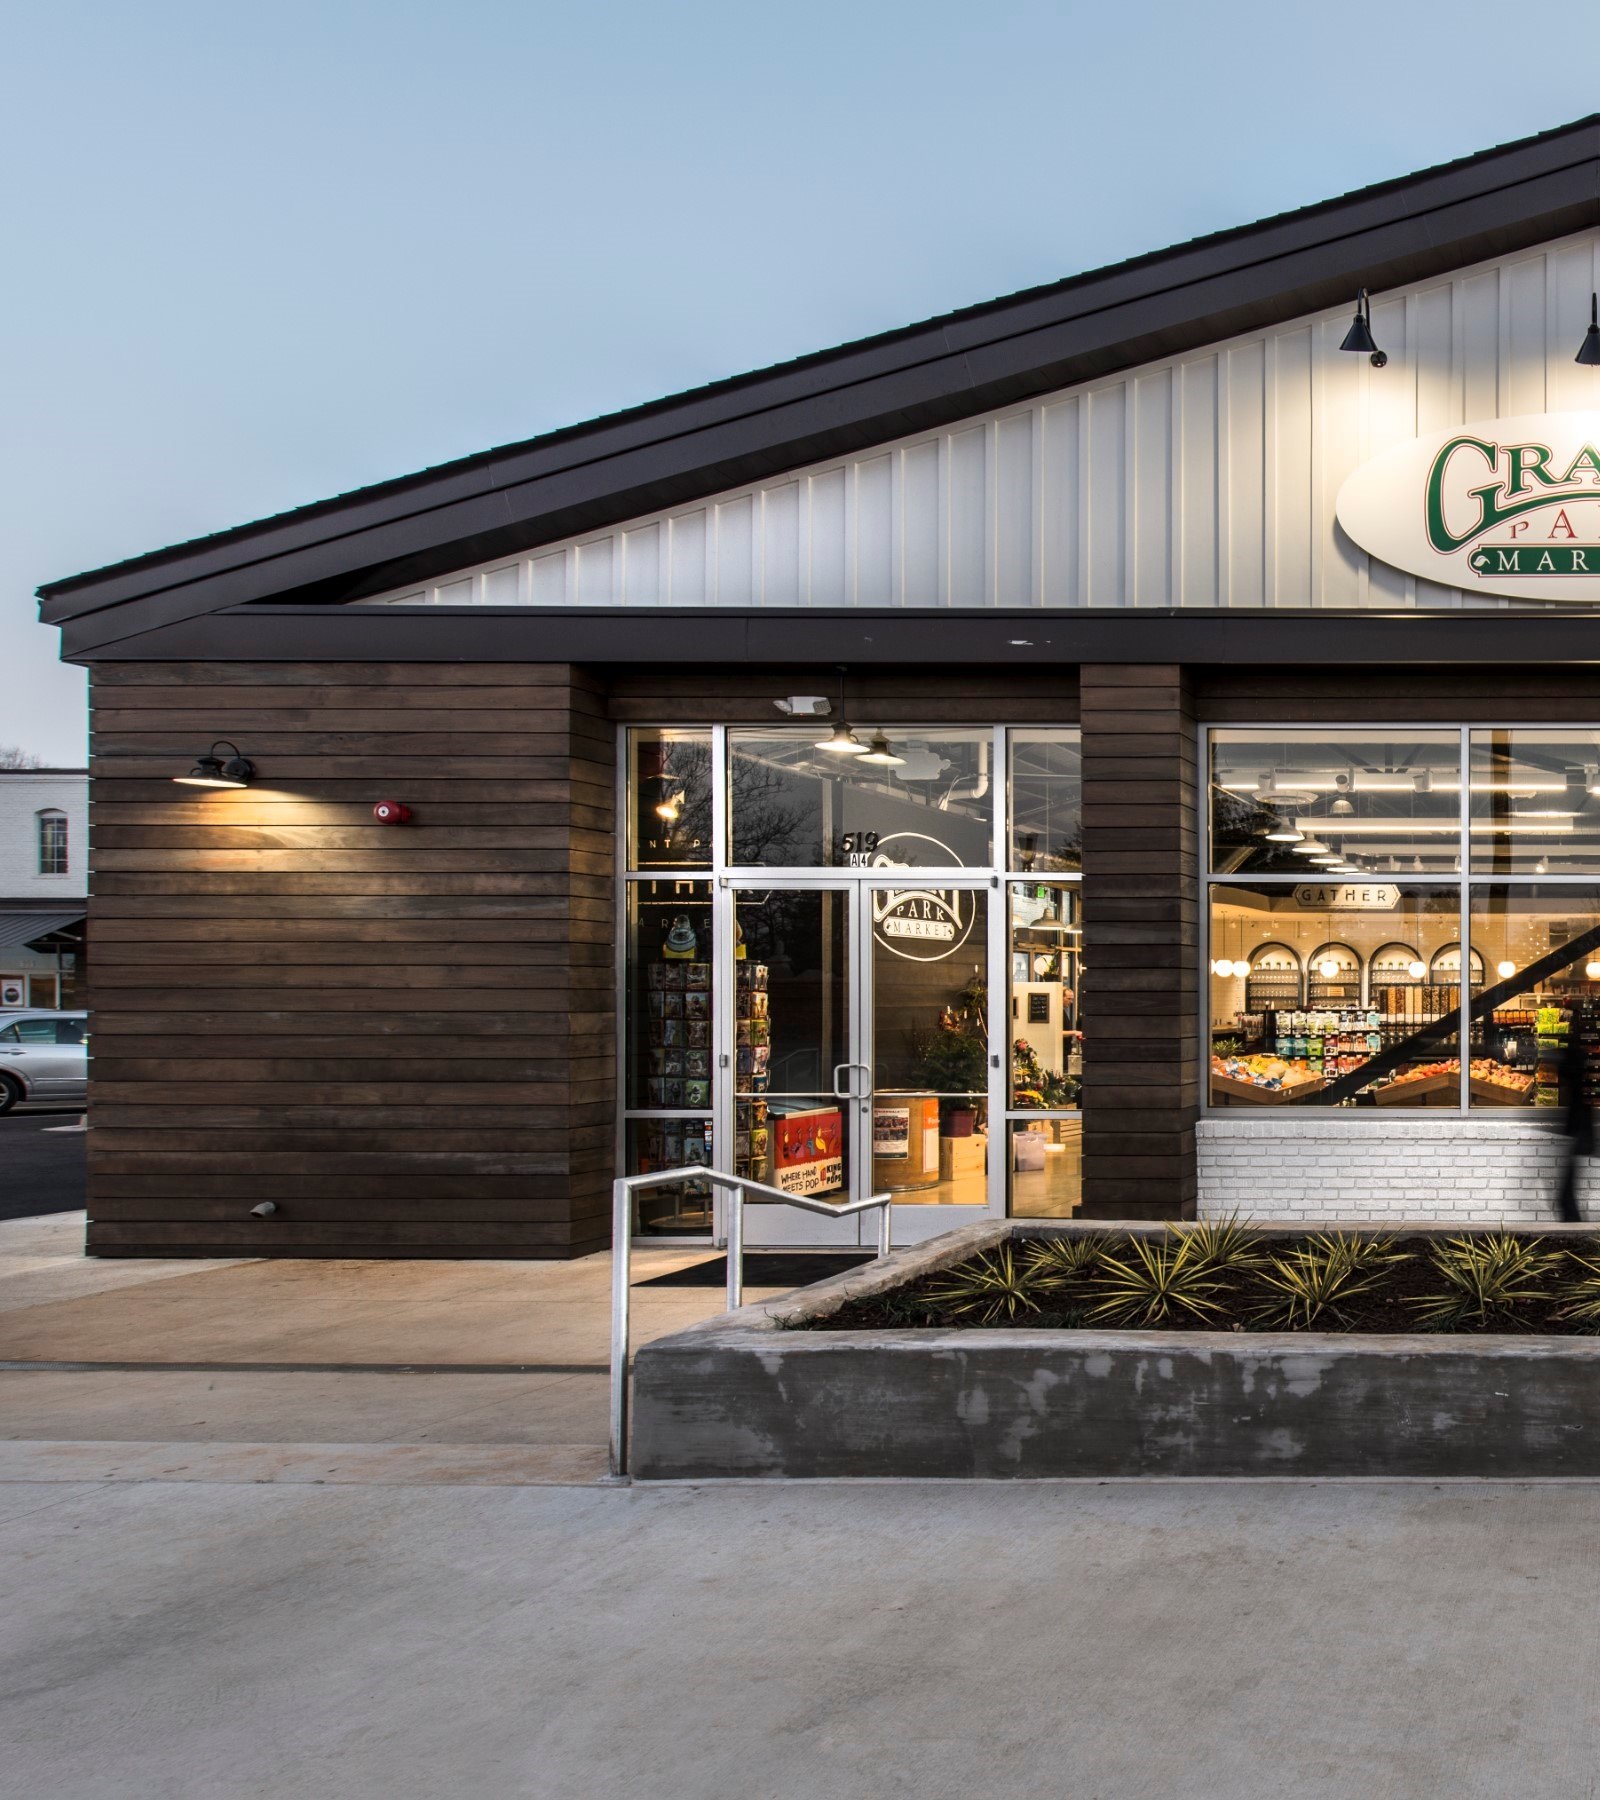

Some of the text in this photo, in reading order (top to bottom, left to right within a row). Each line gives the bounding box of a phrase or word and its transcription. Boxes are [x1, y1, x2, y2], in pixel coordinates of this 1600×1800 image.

[842, 831, 879, 853] 519
[1302, 889, 1387, 901] GATHER
[896, 900, 945, 921] PARK
[893, 921, 948, 937] MARKET
[780, 1170, 801, 1184] WHERE
[805, 1177, 819, 1190] POP
[826, 1174, 841, 1184] POPS
